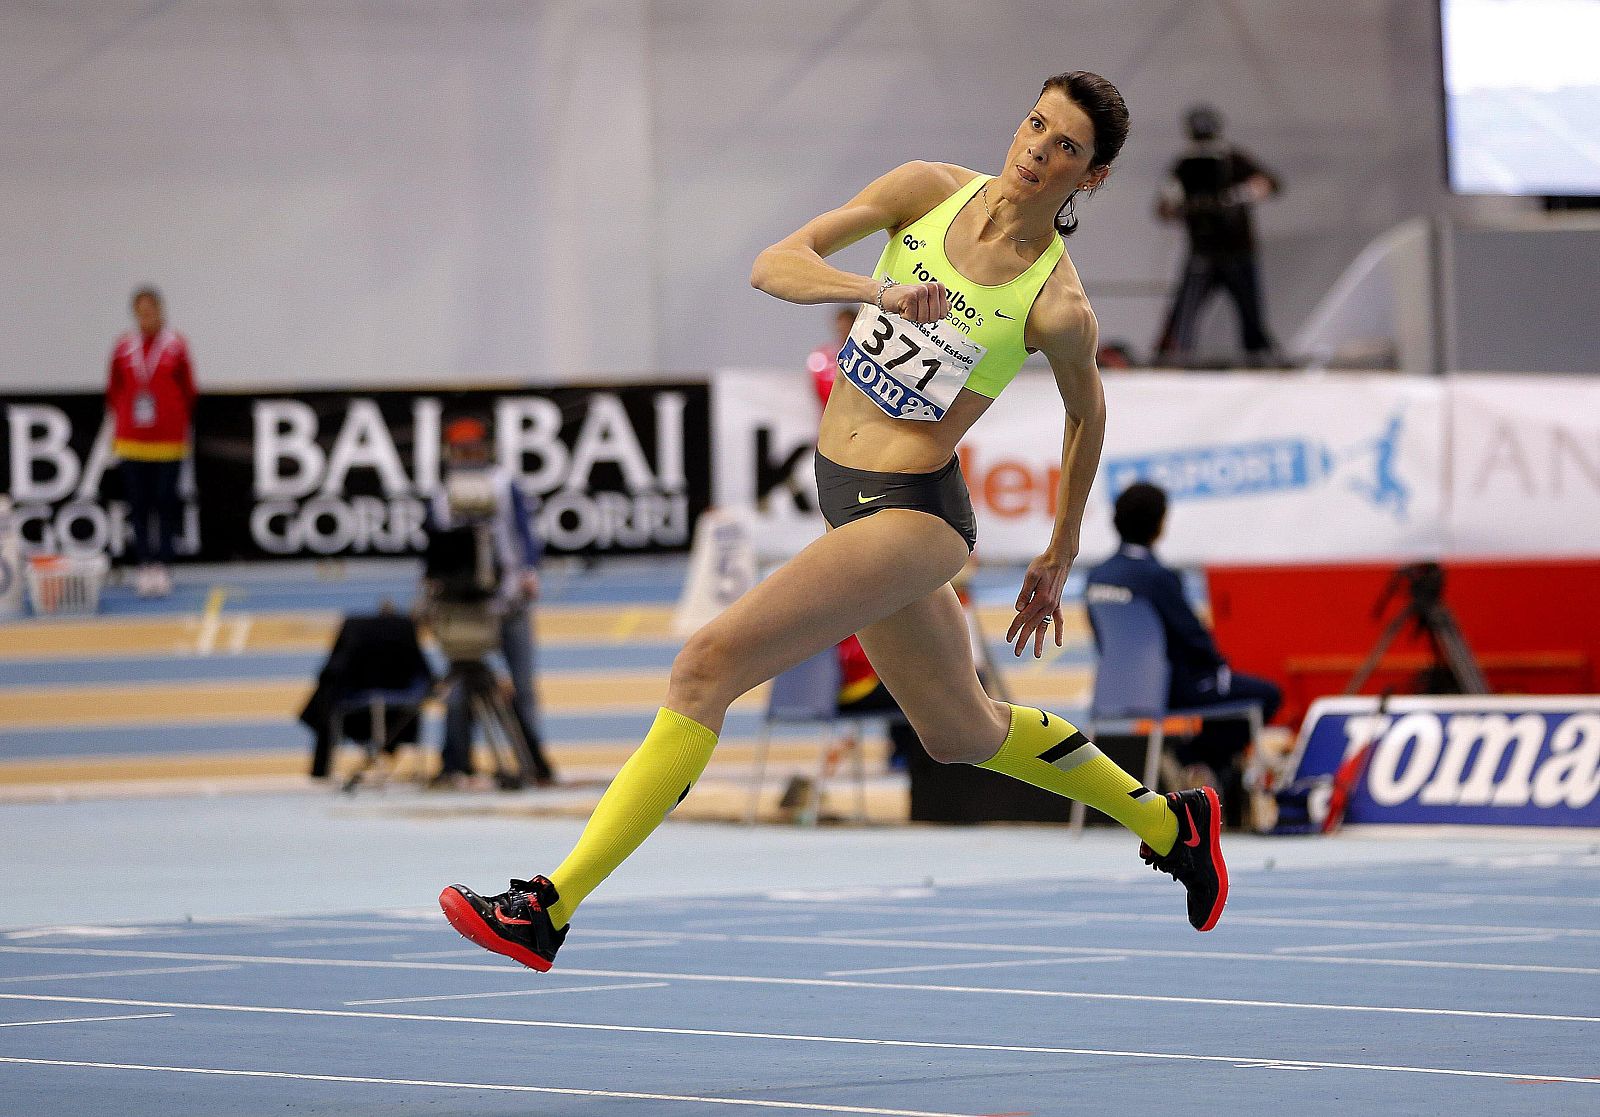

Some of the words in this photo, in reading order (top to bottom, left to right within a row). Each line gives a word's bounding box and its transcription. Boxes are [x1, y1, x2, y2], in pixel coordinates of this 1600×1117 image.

[903, 234, 919, 250] GO
[912, 262, 984, 326] toalbo's
[946, 312, 970, 335] eam
[862, 315, 942, 392] 371
[911, 321, 931, 338] estas
[931, 335, 945, 348] del
[944, 344, 973, 365] Estado
[254, 399, 441, 500] BAI
[496, 393, 687, 498] BAI
[250, 498, 429, 553] GORR
[532, 491, 689, 551] ORRI
